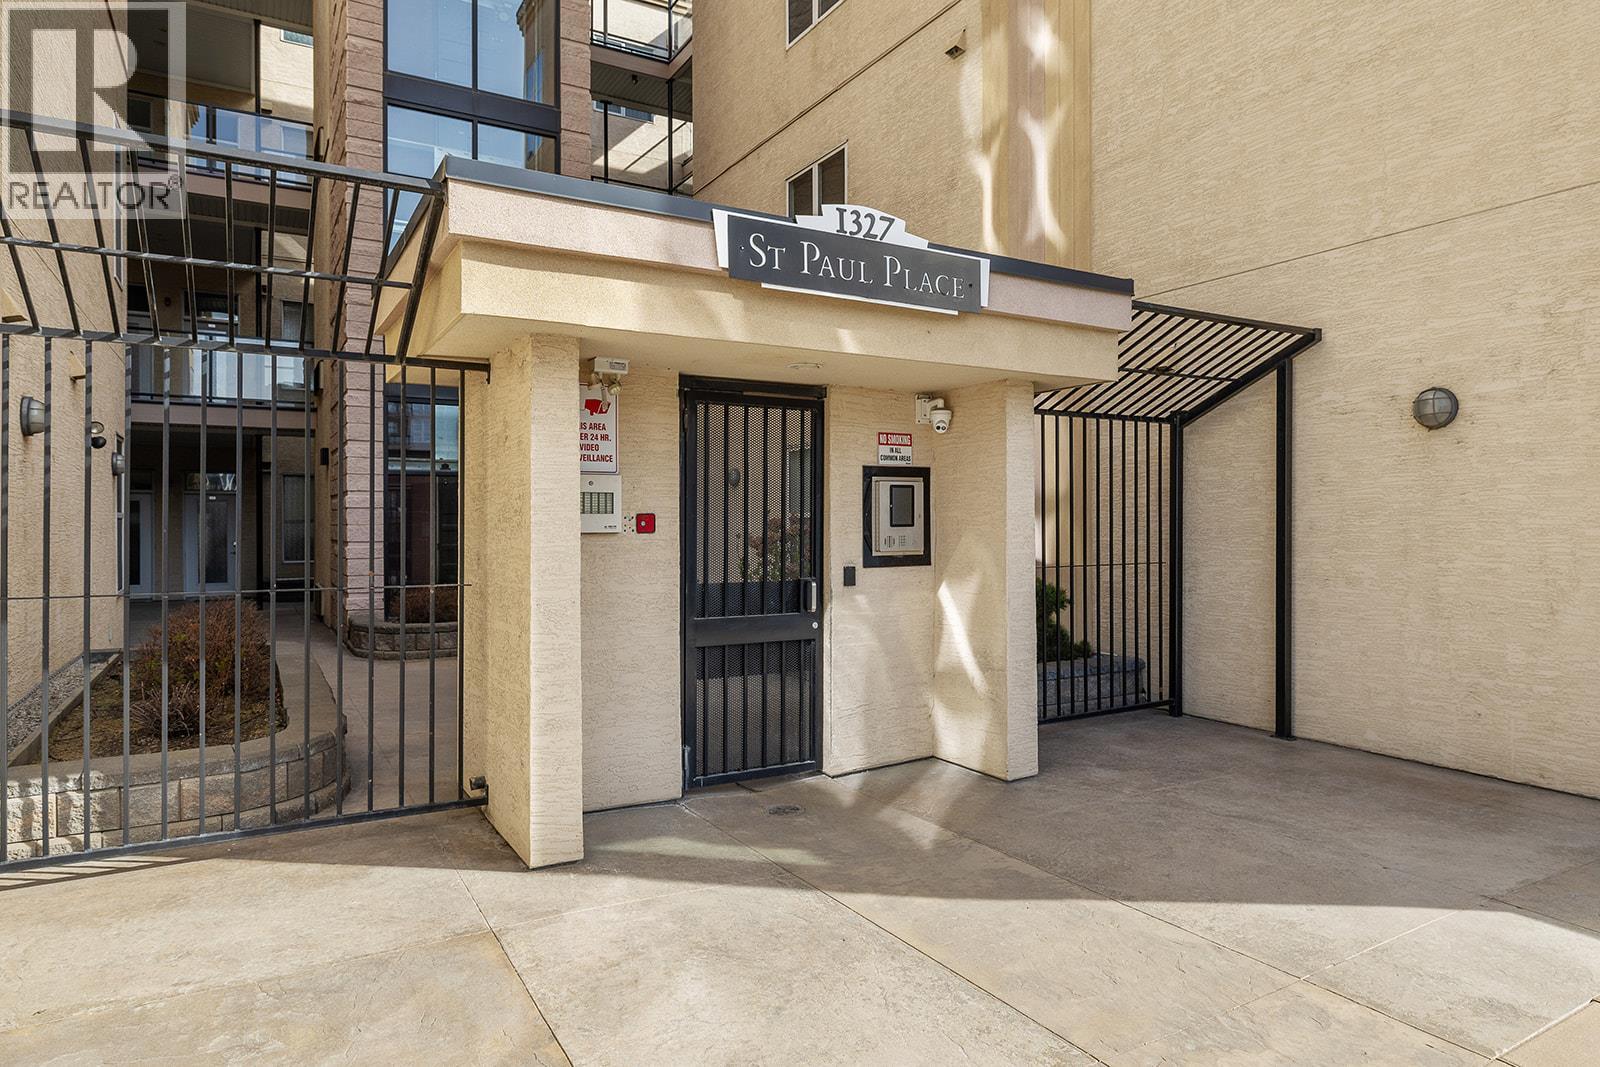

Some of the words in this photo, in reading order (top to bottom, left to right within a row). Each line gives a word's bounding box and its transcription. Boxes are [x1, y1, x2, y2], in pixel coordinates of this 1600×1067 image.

[835, 207, 895, 242] 1327
[749, 232, 786, 270] ST
[799, 241, 873, 285] PAUL
[883, 255, 965, 299] PLACE
[588, 422, 606, 431] AREA
[880, 434, 887, 444] NO
[888, 434, 911, 445] SMOKING
[579, 443, 599, 451] VIDEO
